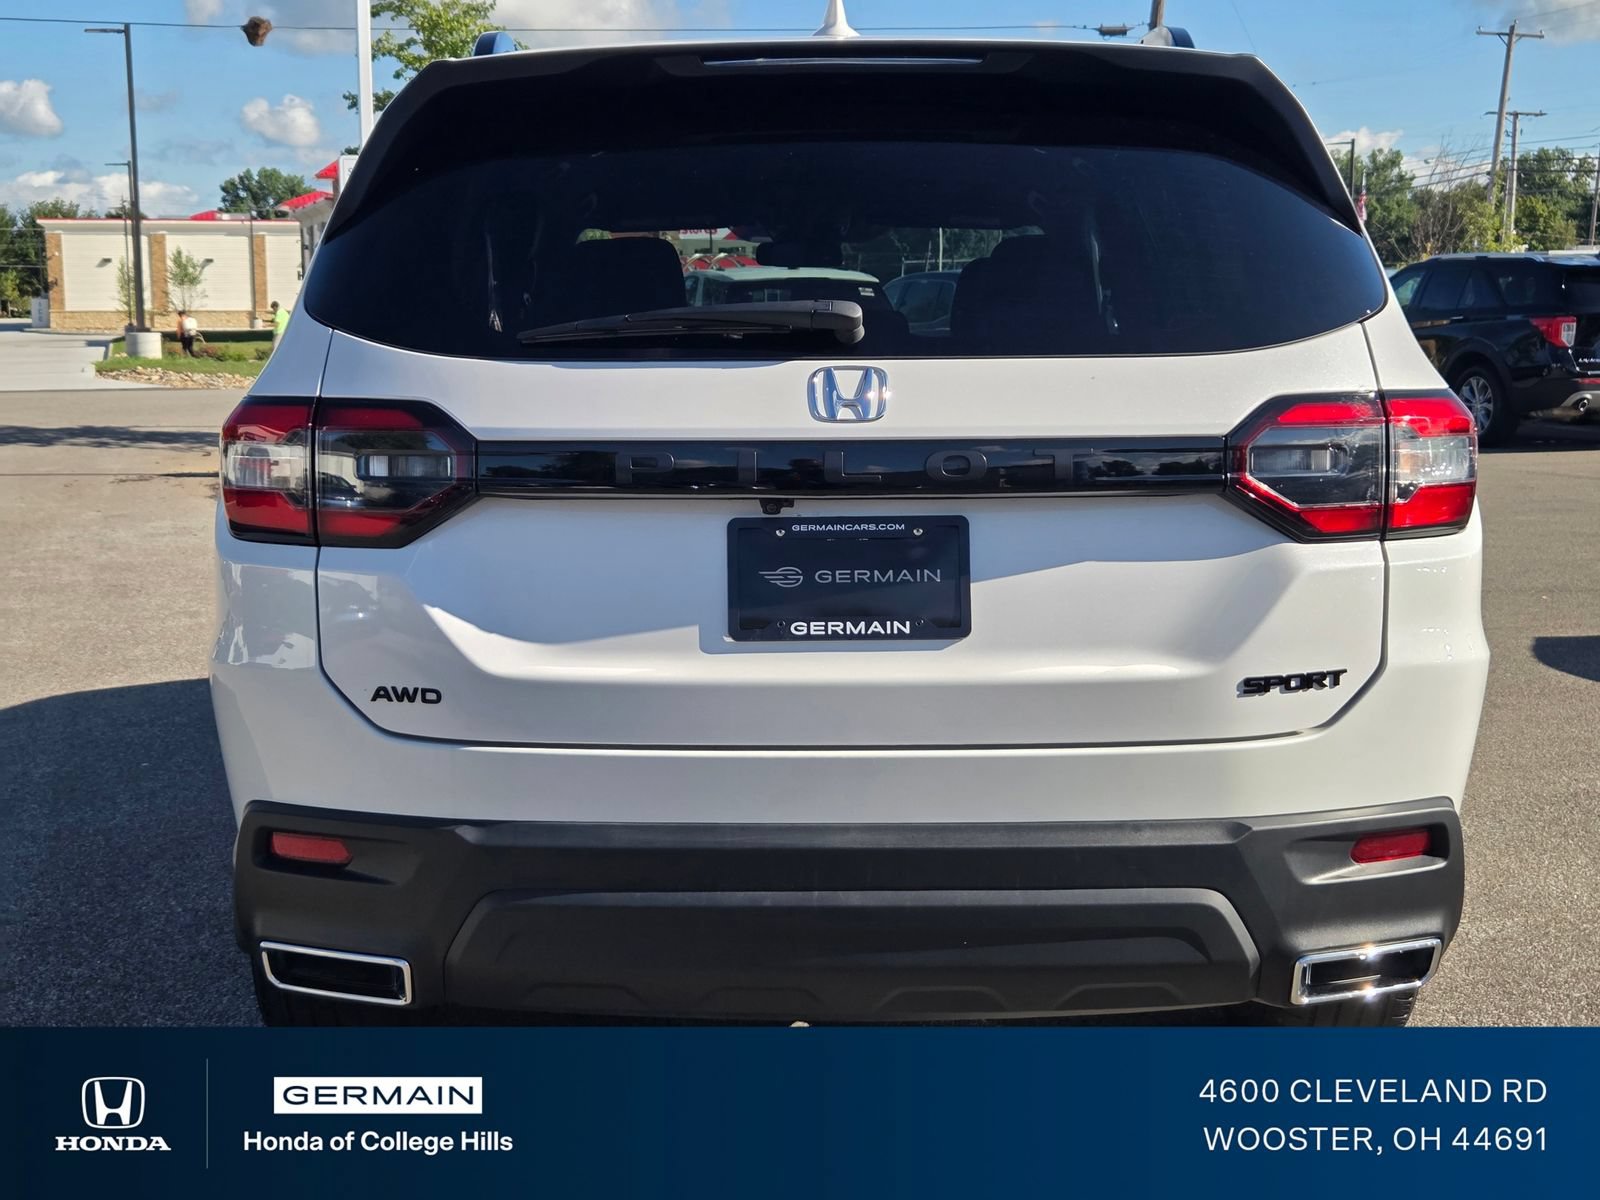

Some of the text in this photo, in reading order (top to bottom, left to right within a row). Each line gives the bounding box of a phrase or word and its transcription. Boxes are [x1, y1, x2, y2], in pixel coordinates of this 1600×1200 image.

[615, 447, 1095, 484] PILOT
[791, 523, 905, 532] GERMAINCARS.COM
[814, 568, 941, 584] GERMAIN
[790, 620, 911, 636] GERMAIN
[1242, 668, 1347, 694] SPORT
[370, 685, 442, 704] AWD
